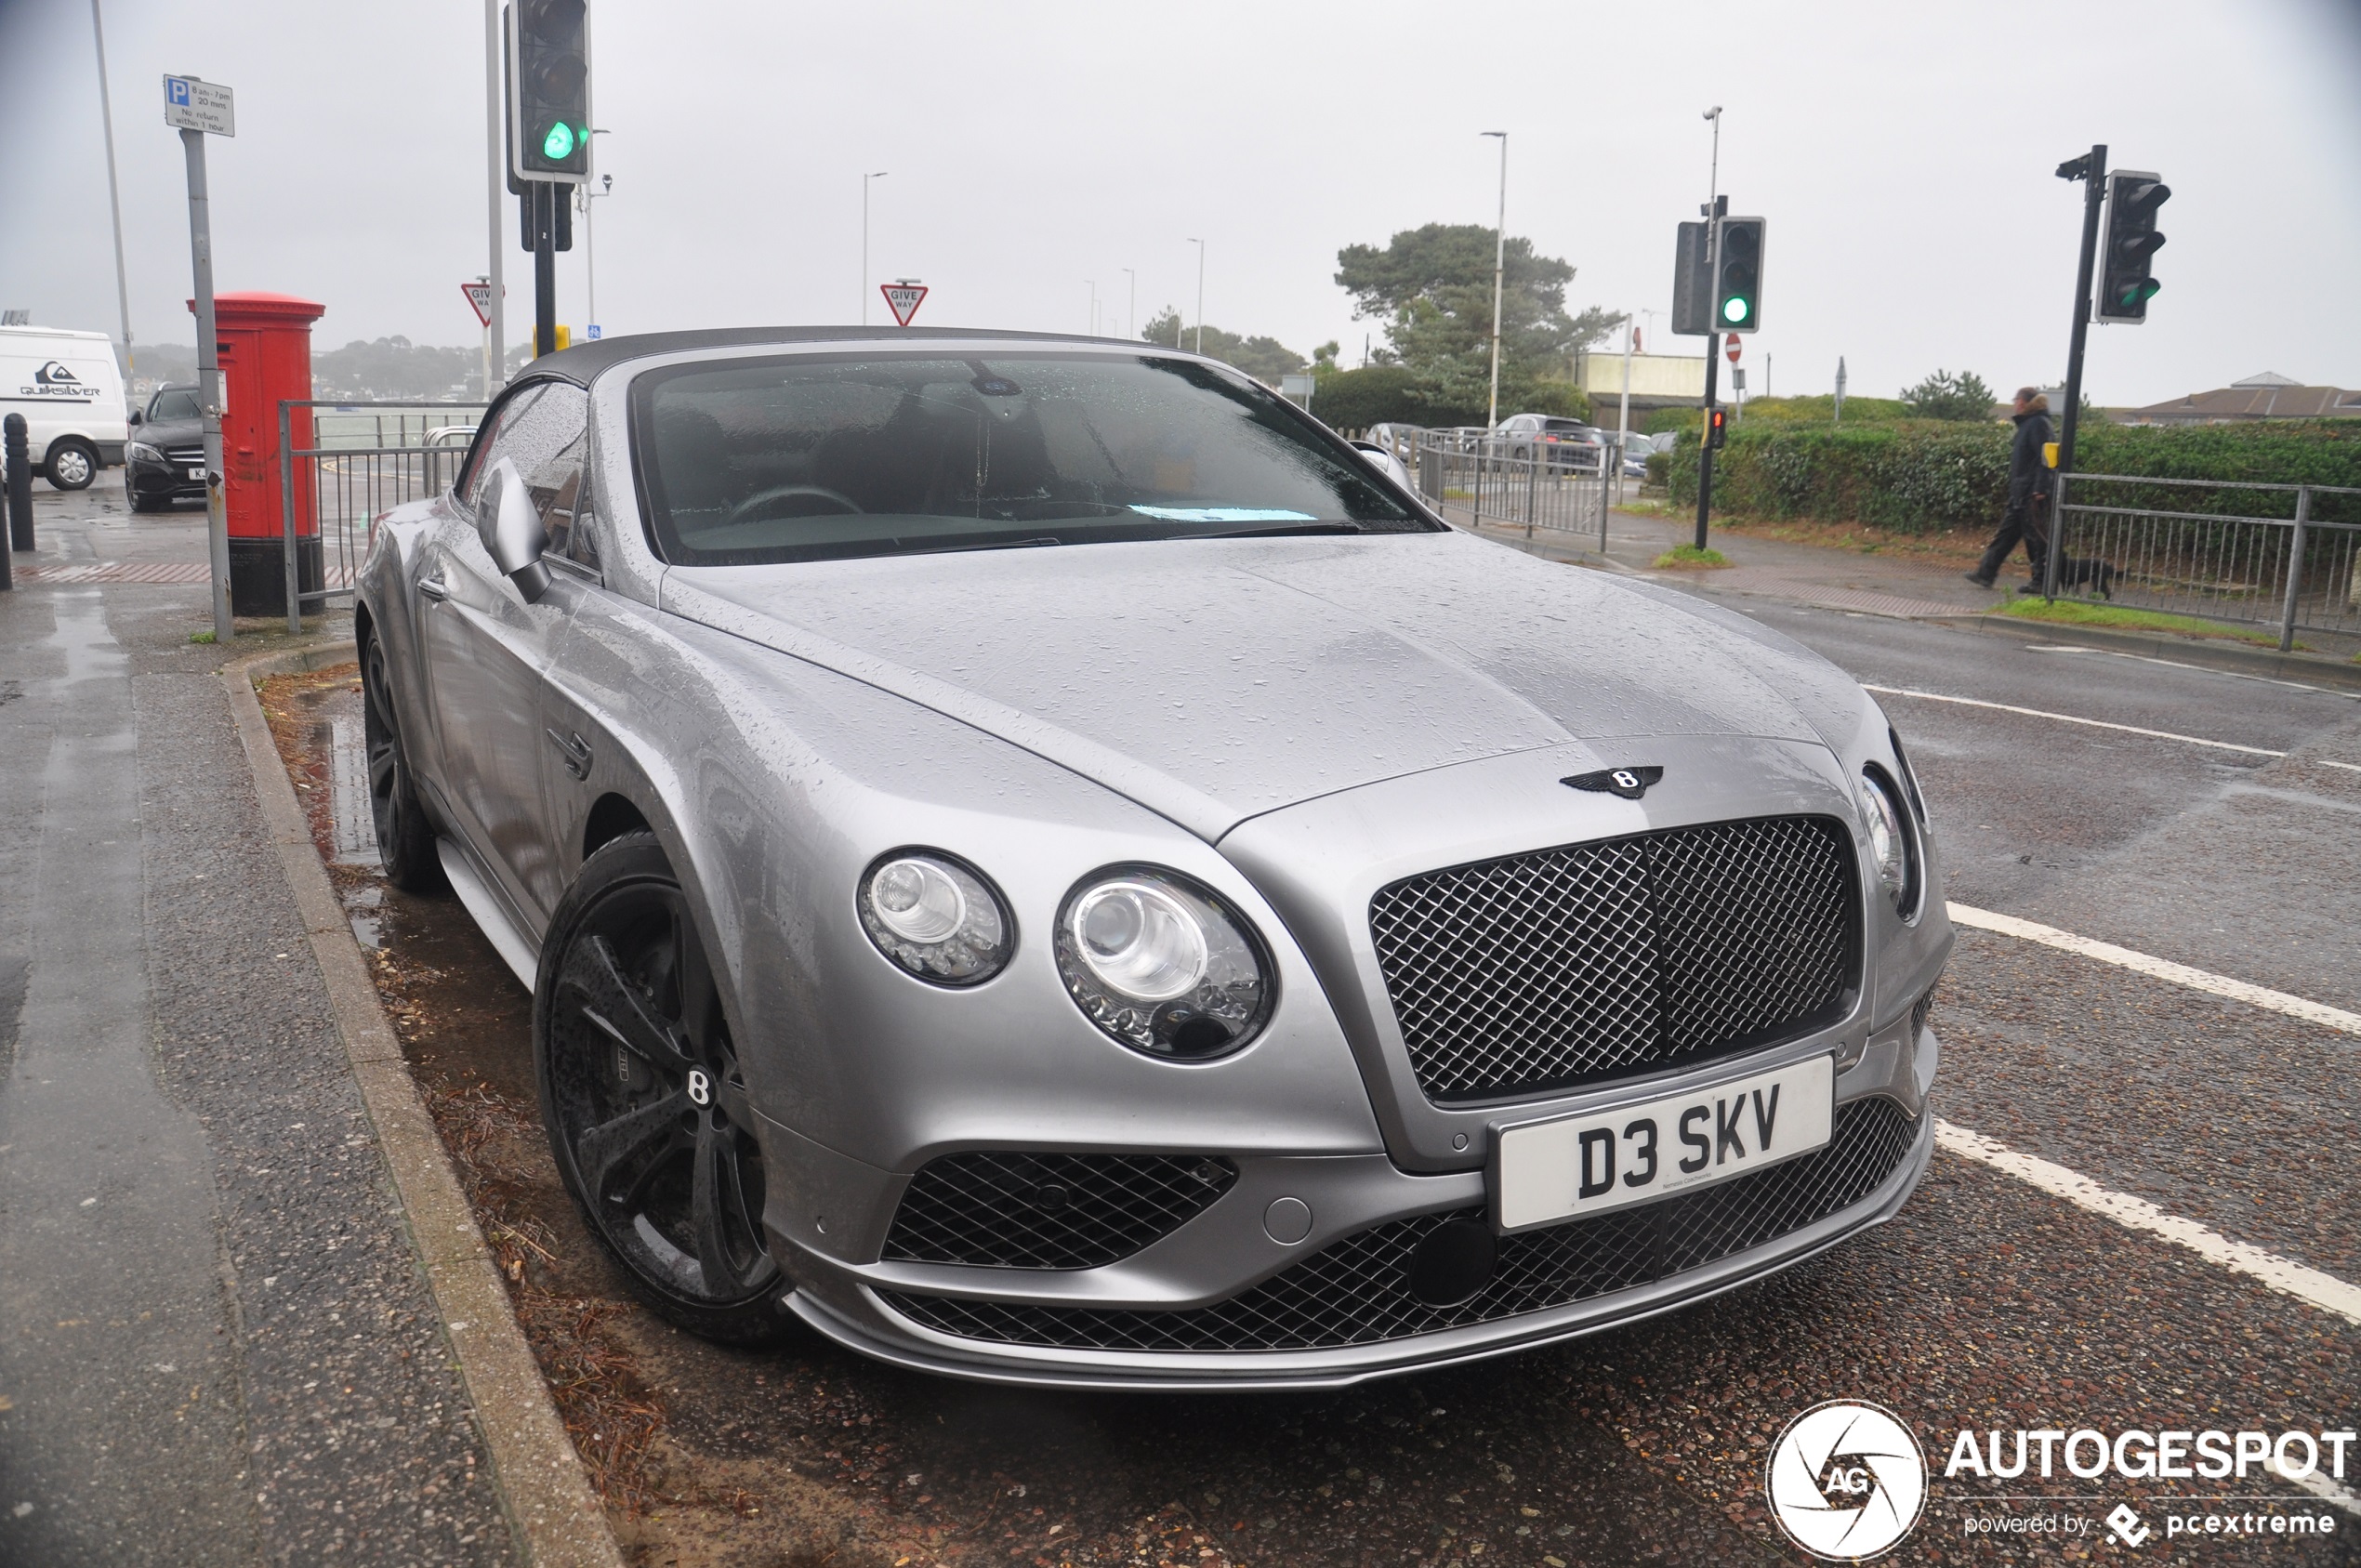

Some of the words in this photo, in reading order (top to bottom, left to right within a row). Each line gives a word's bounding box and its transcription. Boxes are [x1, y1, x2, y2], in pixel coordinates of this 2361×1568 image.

[172, 80, 186, 103] P
[198, 97, 209, 106] 20
[210, 100, 227, 110] mins
[181, 108, 192, 117] No
[196, 112, 219, 122] return
[175, 117, 199, 127] within
[208, 123, 225, 132] hour
[471, 289, 491, 298] GIV
[890, 290, 917, 300] GIVE
[20, 385, 100, 397] QUIKSILVER
[1578, 1117, 1658, 1200] D3
[1678, 1083, 1781, 1175] SKV
